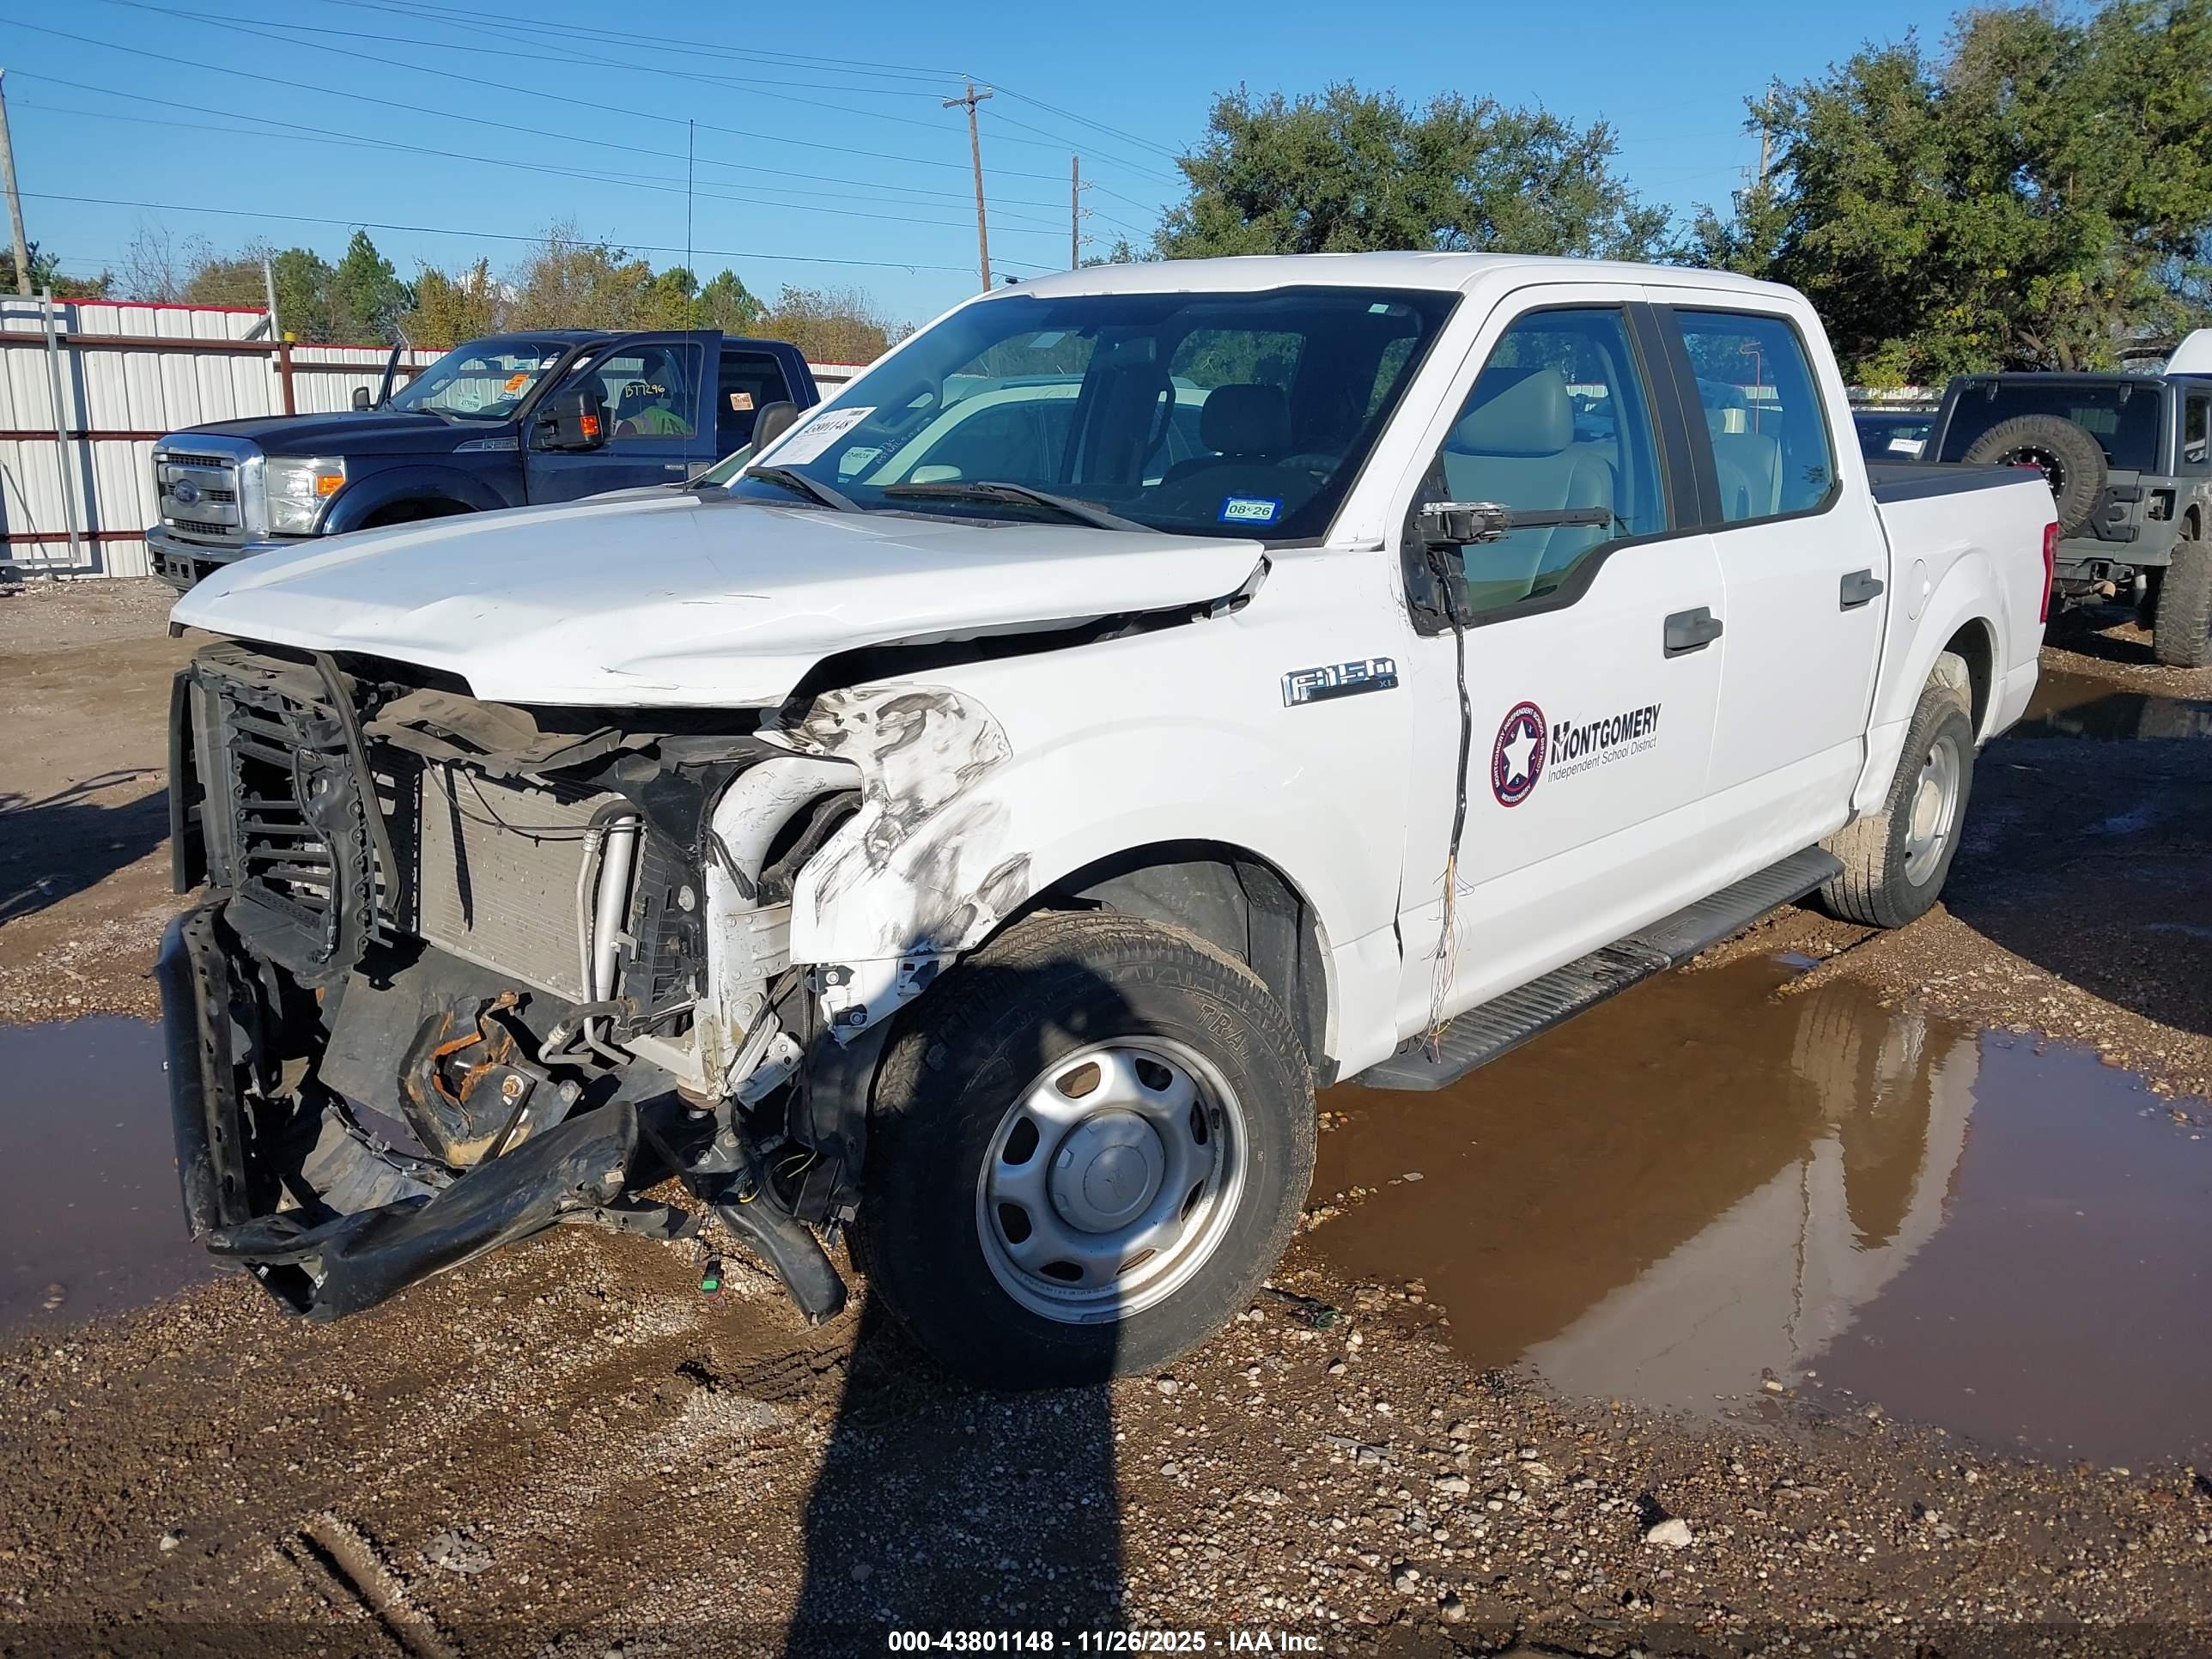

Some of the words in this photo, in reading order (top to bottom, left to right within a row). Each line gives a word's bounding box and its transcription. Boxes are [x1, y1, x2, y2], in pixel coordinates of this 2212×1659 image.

[1228, 504, 1246, 514] 08
[1253, 507, 1270, 516] 26
[1379, 678, 1395, 689] XL
[1550, 702, 1662, 766] MONTGOMERY
[1547, 755, 1601, 784] Independent
[1601, 746, 1630, 765] School
[1630, 734, 1658, 757] District
